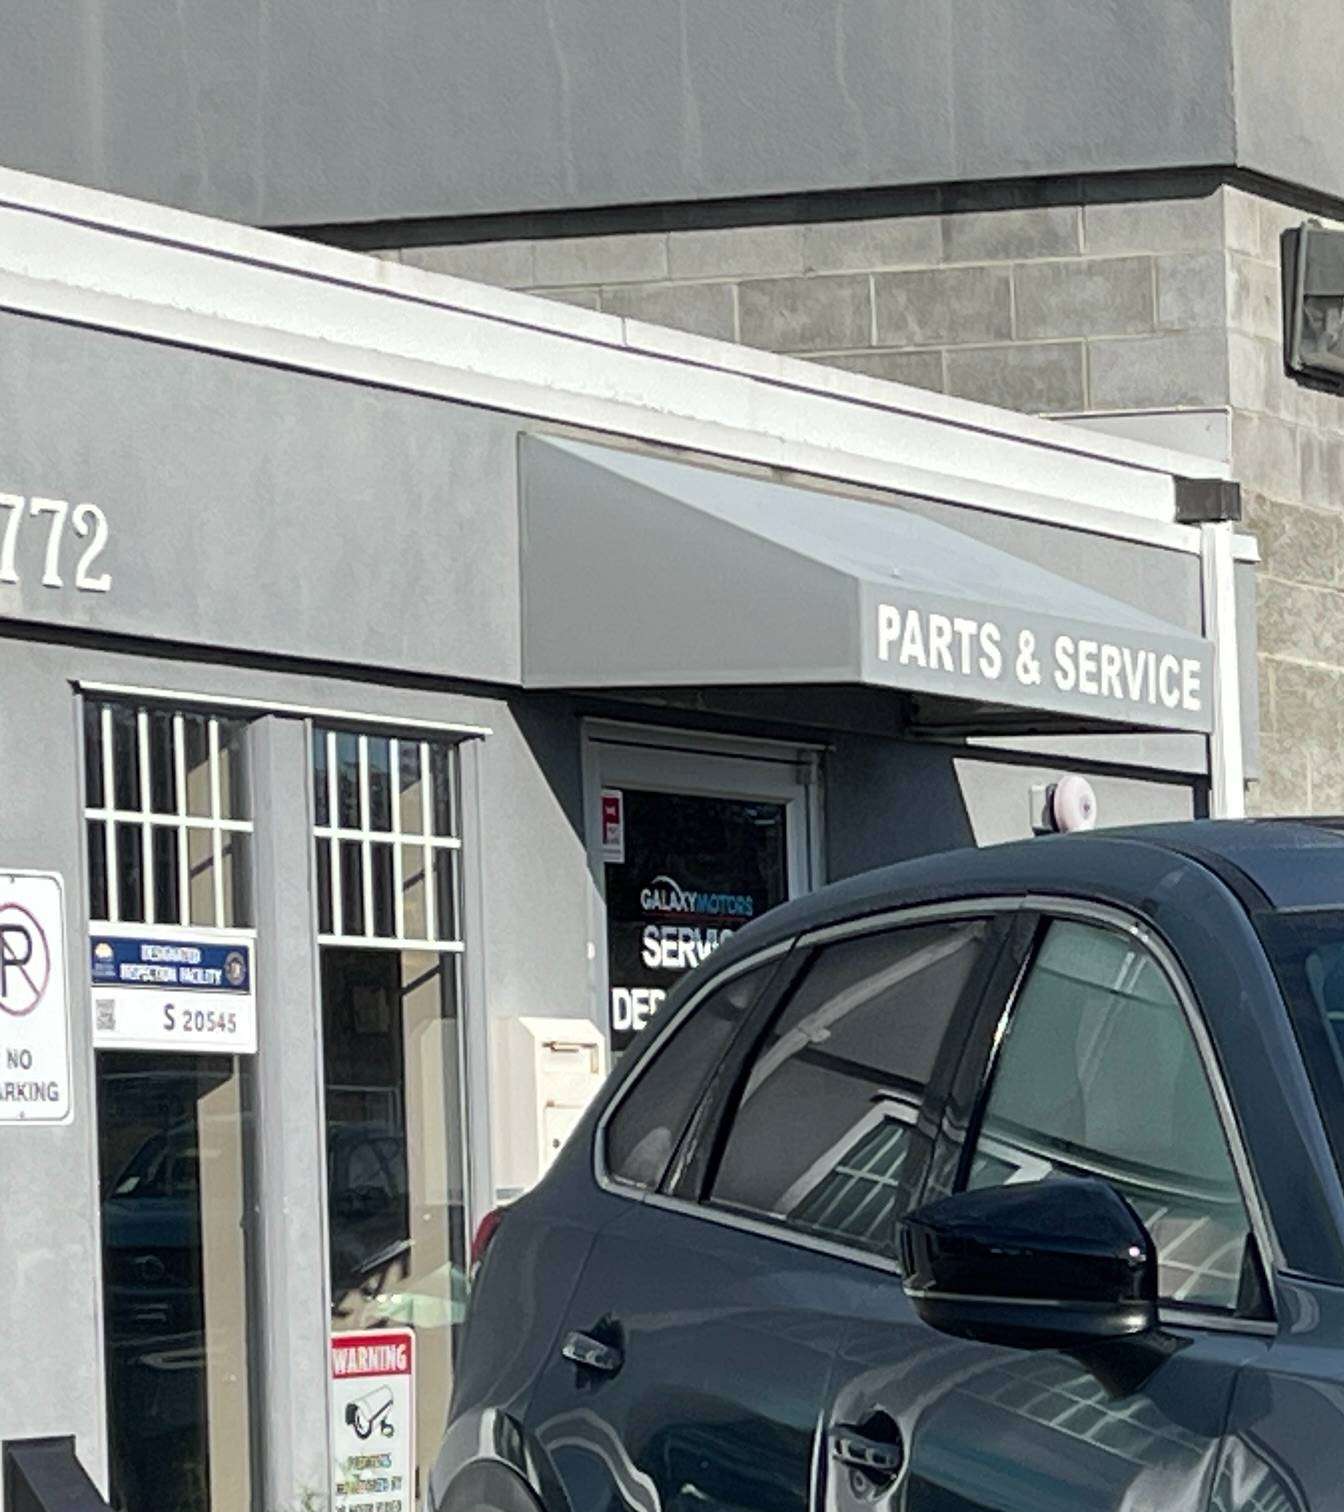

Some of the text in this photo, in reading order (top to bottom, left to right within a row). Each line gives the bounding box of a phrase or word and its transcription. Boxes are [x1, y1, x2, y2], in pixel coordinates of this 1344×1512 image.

[0, 492, 112, 592] 772
[877, 604, 1201, 711] PARTS & SERVICE
[163, 1003, 236, 1034] S 20545
[7, 1049, 33, 1070] NO
[0, 1080, 60, 1102] RKING
[332, 1344, 407, 1375] WARNING
